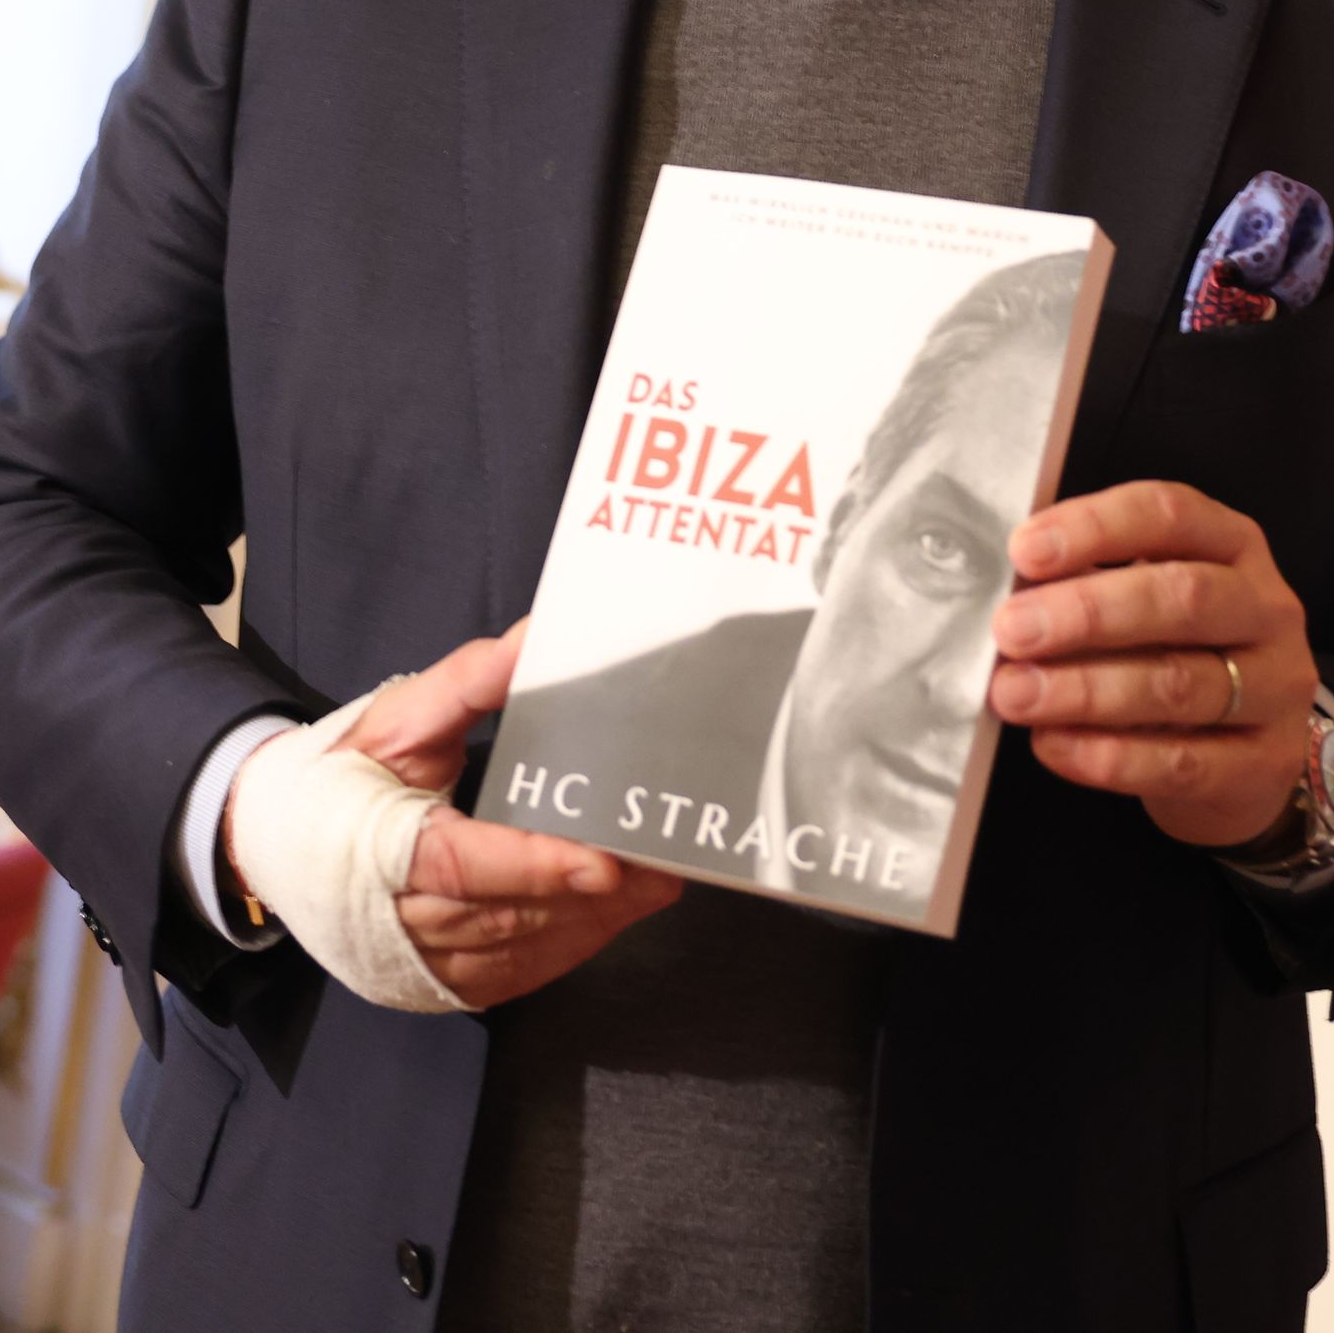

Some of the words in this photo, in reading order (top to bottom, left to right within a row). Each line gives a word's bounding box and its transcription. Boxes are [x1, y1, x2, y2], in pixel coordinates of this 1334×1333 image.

[626, 372, 698, 412] DAS
[605, 412, 817, 519] IBIZA
[586, 493, 813, 565] ATTENTAT
[505, 762, 591, 819] HC
[617, 784, 915, 891] STRACHE
